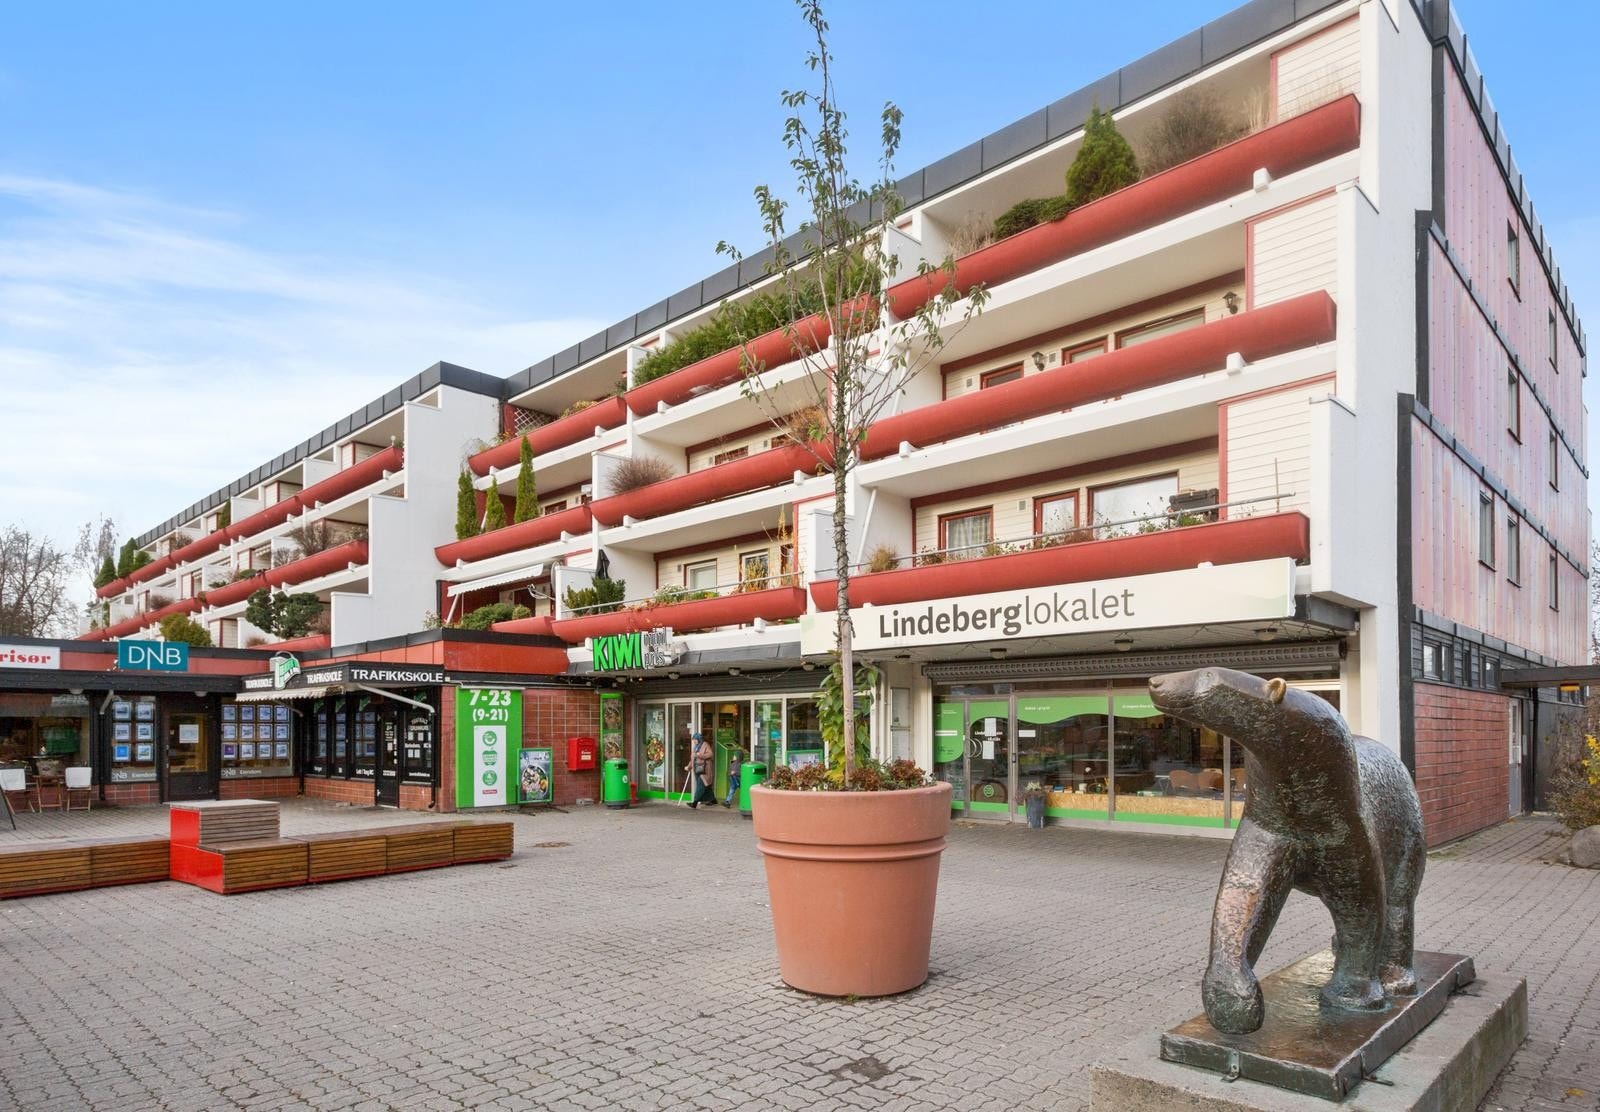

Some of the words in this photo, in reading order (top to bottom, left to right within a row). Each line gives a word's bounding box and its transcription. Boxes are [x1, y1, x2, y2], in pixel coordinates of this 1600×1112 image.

[880, 588, 1135, 636] Lindeberglokalet
[128, 641, 182, 670] DNB
[593, 632, 643, 671] KIWI
[351, 669, 443, 682] TRAFIKKSKOLE
[469, 690, 511, 706] 7-23
[472, 708, 509, 722] (9-21)
